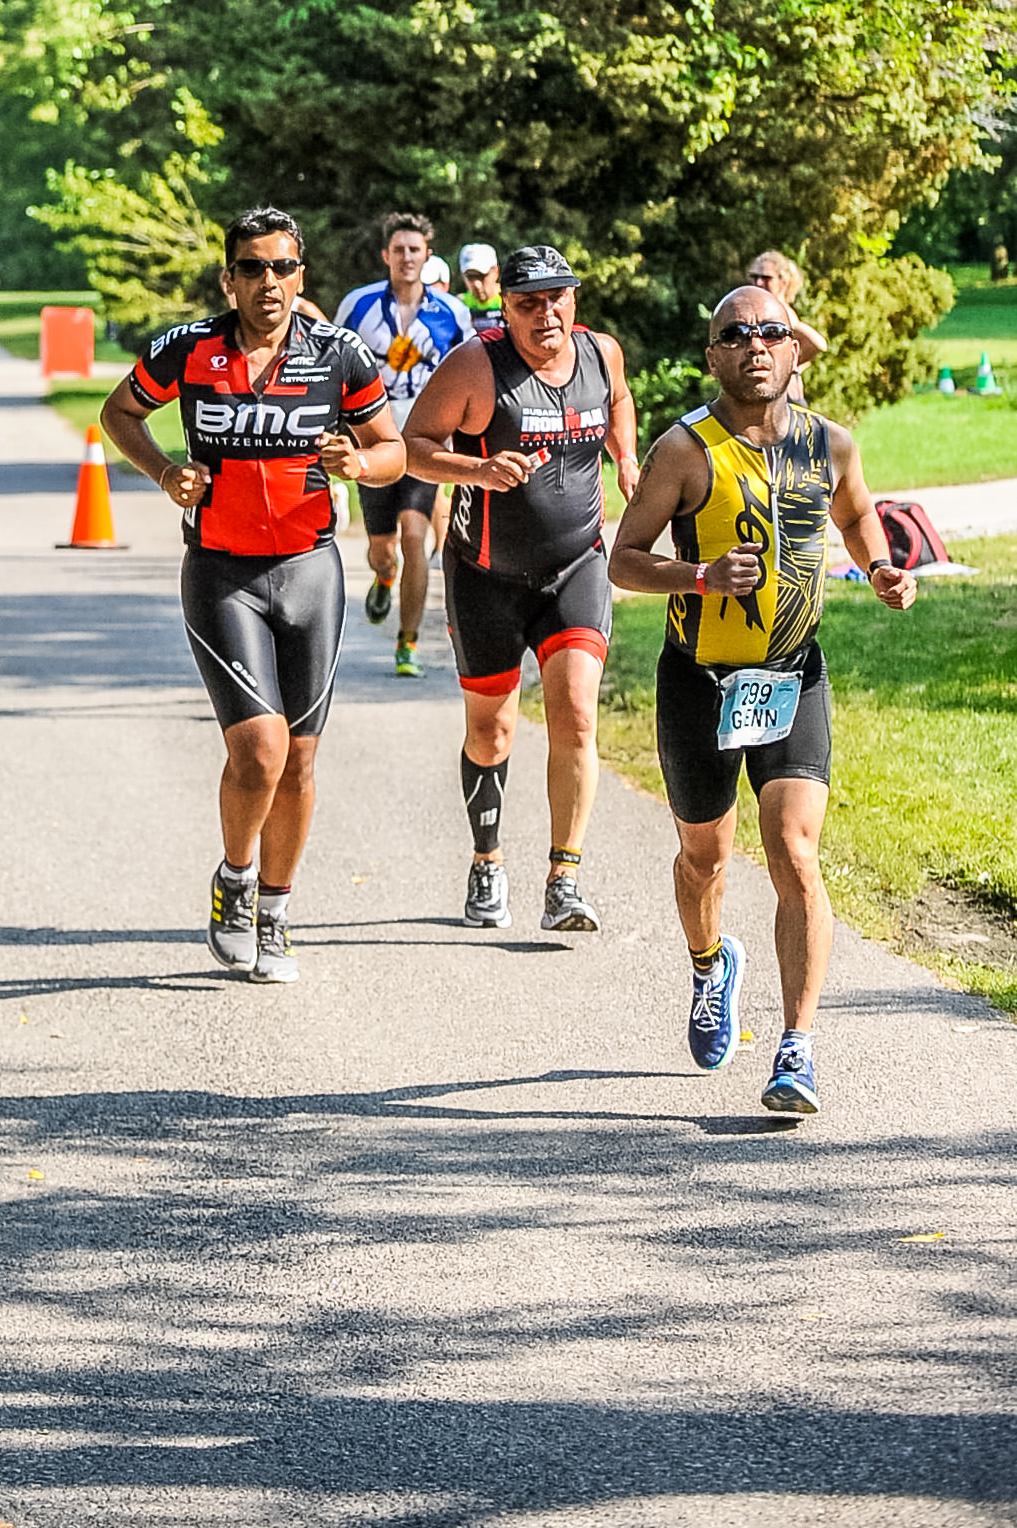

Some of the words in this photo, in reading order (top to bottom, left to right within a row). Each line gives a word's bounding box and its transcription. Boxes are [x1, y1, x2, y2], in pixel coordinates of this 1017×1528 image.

[149, 318, 214, 360] BMC
[310, 318, 377, 369] BMC
[195, 399, 331, 437] BMC
[522, 407, 562, 417] SUBARU
[196, 432, 310, 448] SWITZERLAND
[740, 682, 773, 706] 299
[731, 708, 778, 730] GENN
